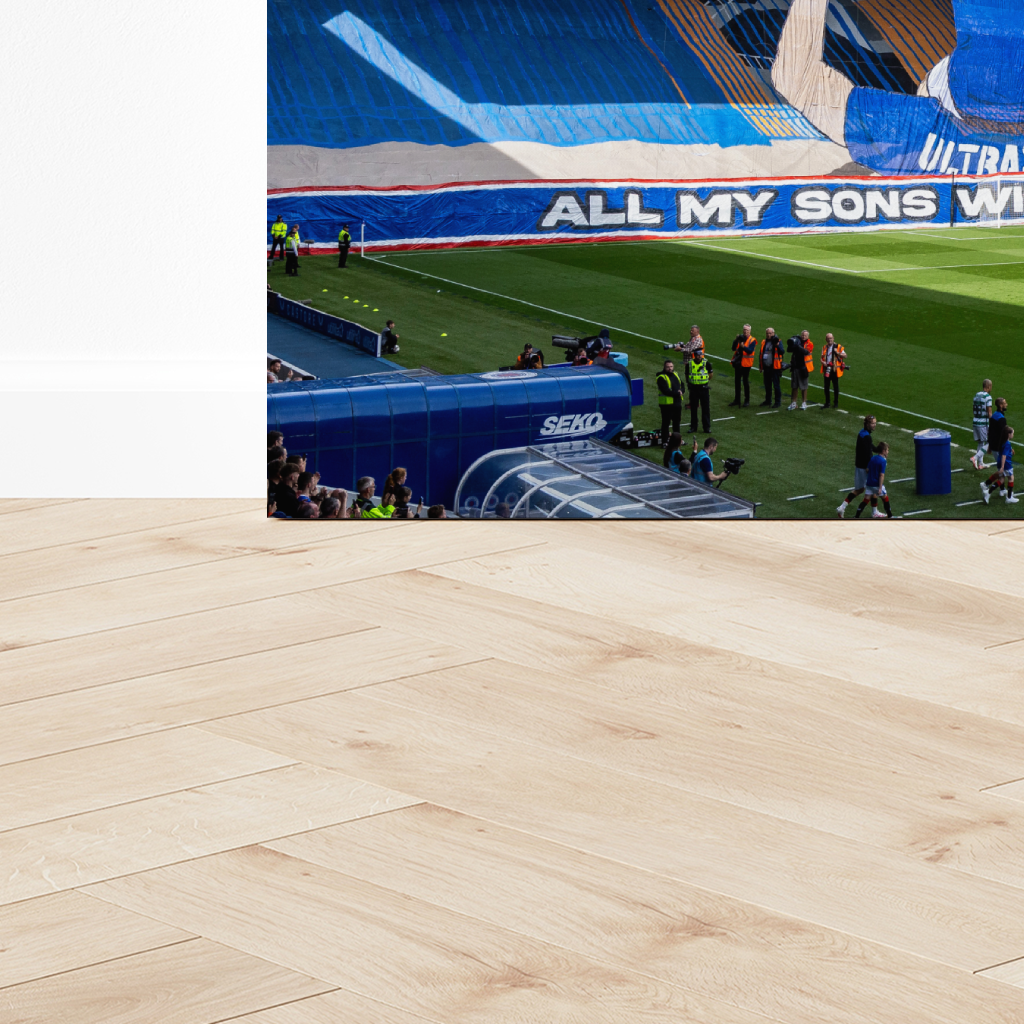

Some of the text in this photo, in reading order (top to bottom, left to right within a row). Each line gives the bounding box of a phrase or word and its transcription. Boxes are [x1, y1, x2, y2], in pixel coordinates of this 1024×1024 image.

[539, 192, 662, 228] ALL
[677, 190, 777, 226] MY
[793, 188, 938, 222] SONS
[539, 412, 608, 436] SEKO
